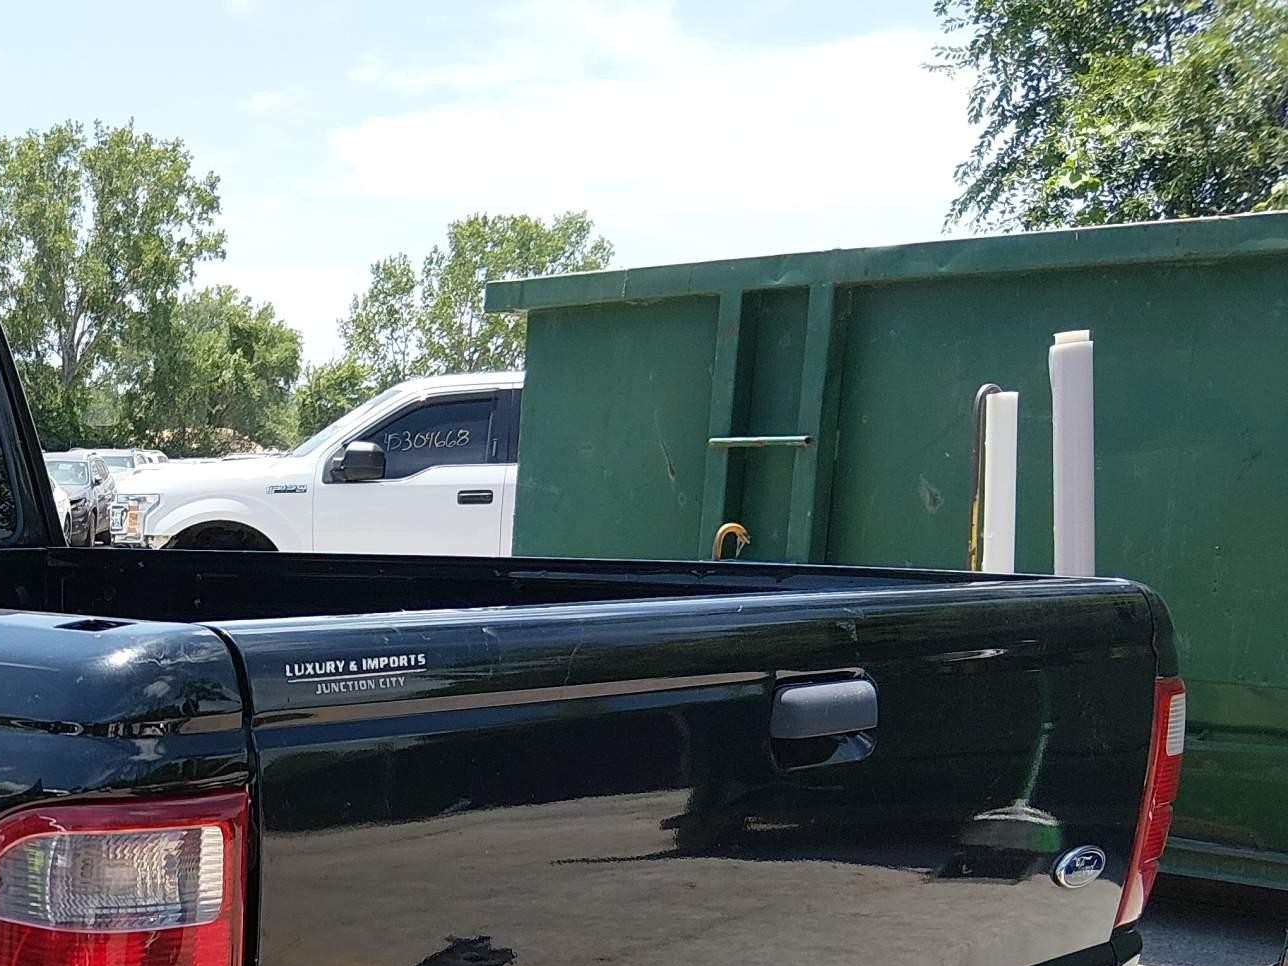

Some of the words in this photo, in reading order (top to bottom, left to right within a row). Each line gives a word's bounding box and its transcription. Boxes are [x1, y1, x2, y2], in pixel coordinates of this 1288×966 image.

[383, 429, 470, 451] 45304668
[285, 660, 345, 677] LUXURY
[349, 660, 358, 672] &
[362, 653, 426, 670] IMPORTS
[315, 679, 376, 695] JUNCTION
[379, 676, 405, 688] CITY
